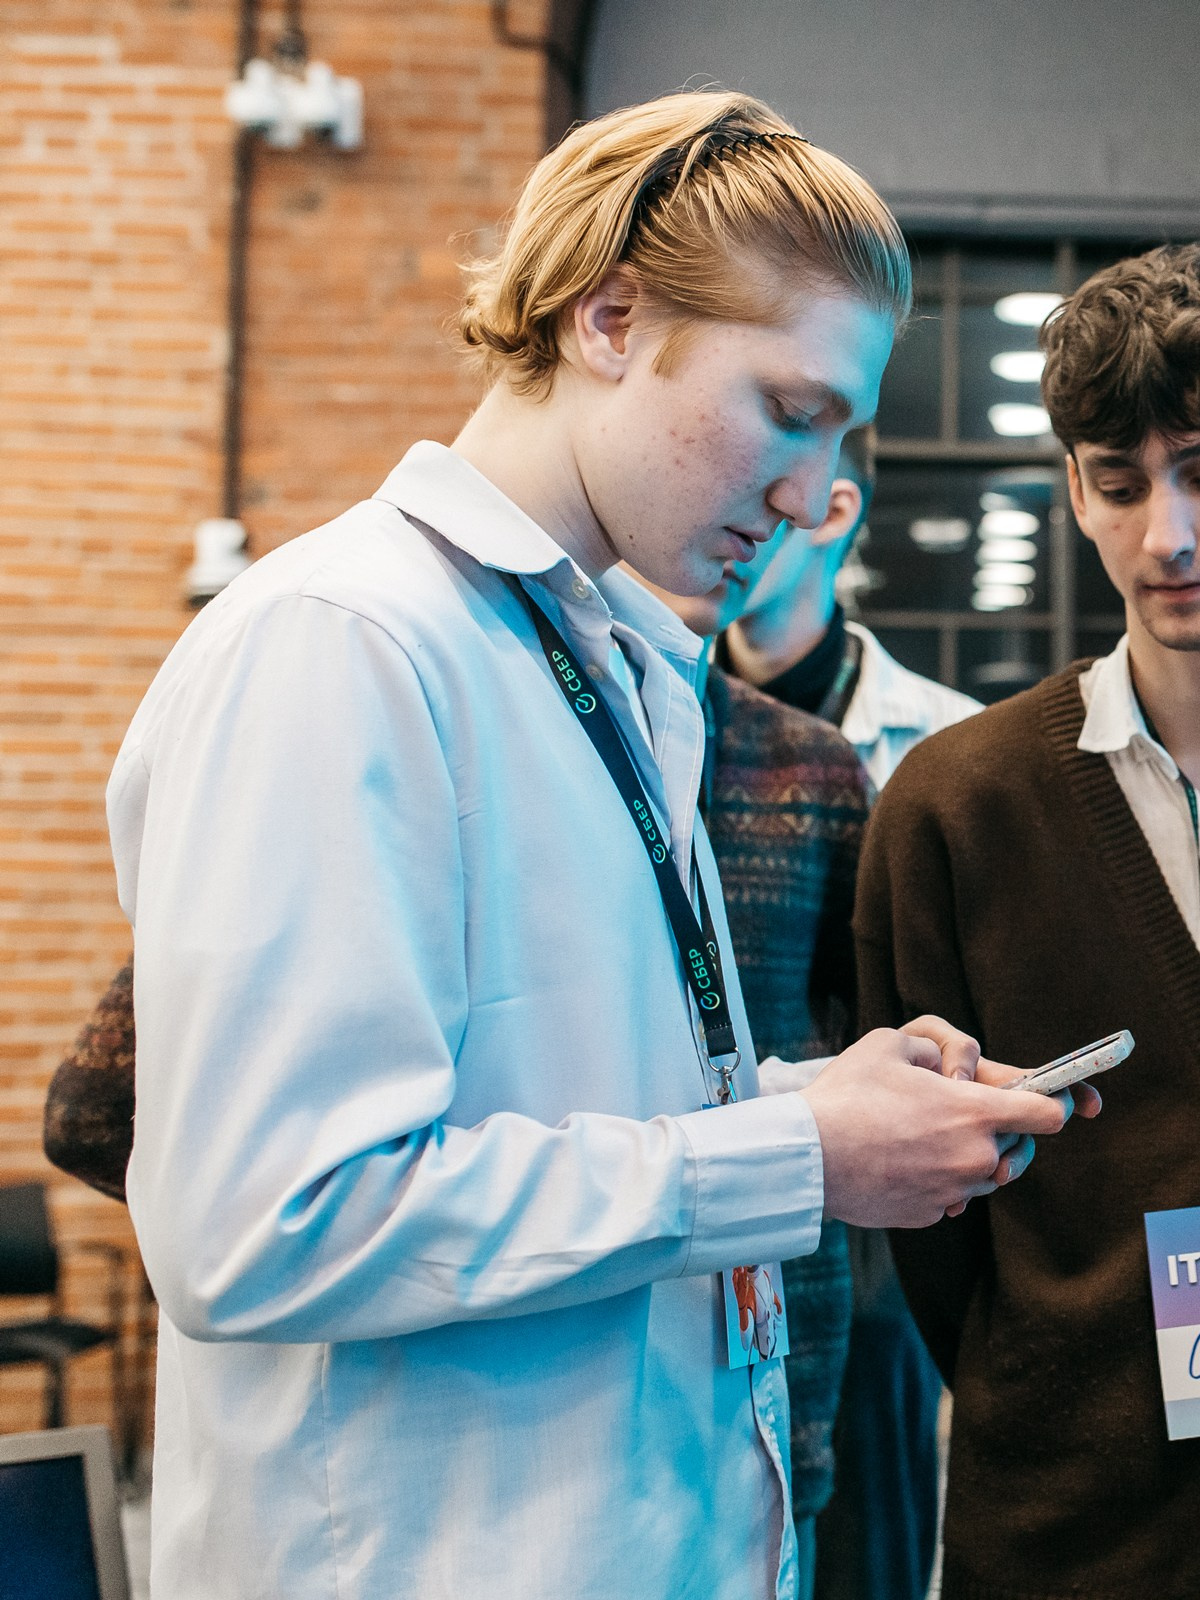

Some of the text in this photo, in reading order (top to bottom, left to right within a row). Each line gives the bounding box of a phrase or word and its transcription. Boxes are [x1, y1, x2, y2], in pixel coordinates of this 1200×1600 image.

[552, 650, 582, 692] СБЕР
[633, 799, 657, 842] СБЕР
[688, 948, 711, 989] СБЕР
